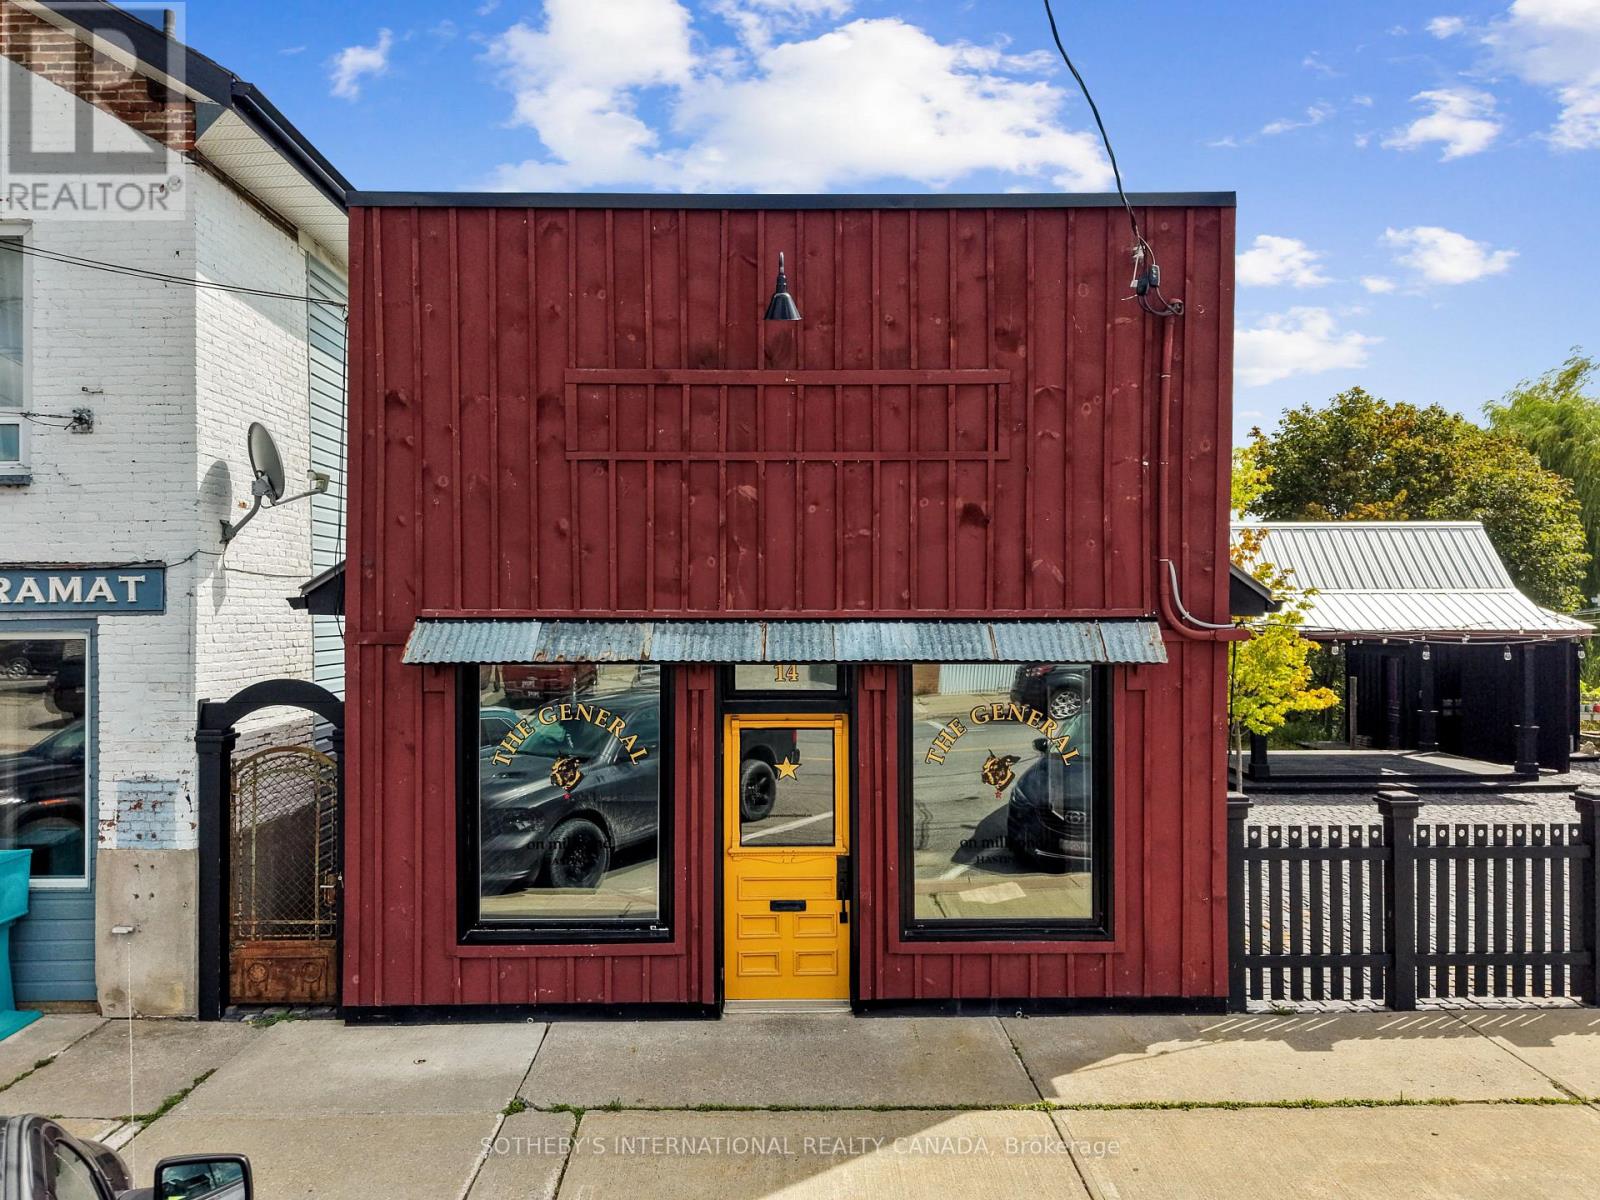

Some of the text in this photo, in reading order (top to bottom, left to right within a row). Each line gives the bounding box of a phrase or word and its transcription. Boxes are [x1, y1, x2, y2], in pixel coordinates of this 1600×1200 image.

[774, 664, 799, 682] 14
[491, 703, 649, 767] THE GENERAL
[925, 702, 1080, 766] THE GENERAL
[960, 839, 977, 849] on
